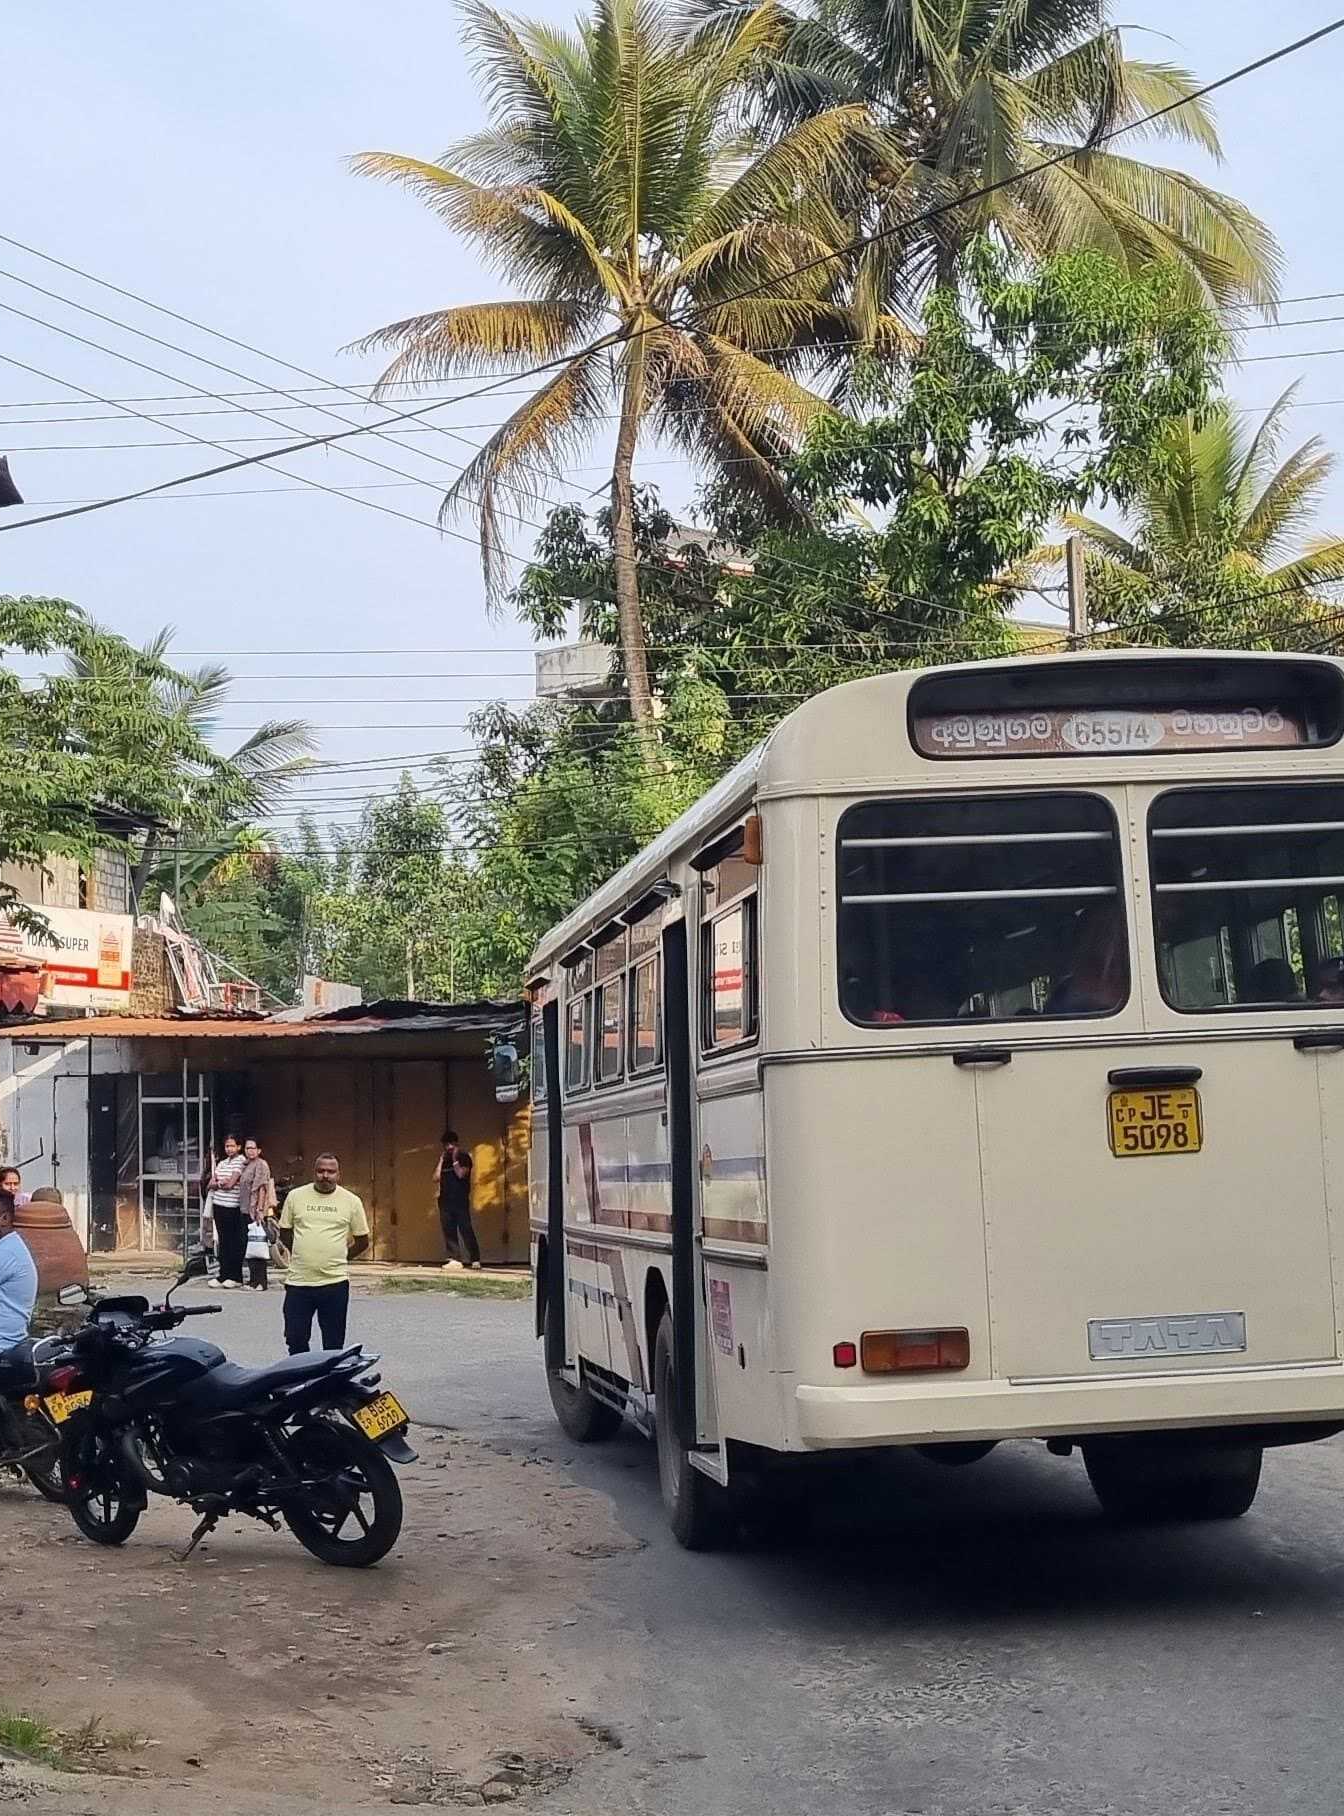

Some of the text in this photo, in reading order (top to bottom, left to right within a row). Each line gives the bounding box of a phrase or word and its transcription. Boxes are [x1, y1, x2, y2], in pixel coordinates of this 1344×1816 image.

[1076, 719, 1149, 745] 655/4
[59, 936, 89, 951] SUPER
[1141, 1095, 1174, 1120] JE
[1124, 1123, 1188, 1150] 5098
[306, 1205, 337, 1213] CALIFORNIA
[1100, 1318, 1233, 1352] TATA
